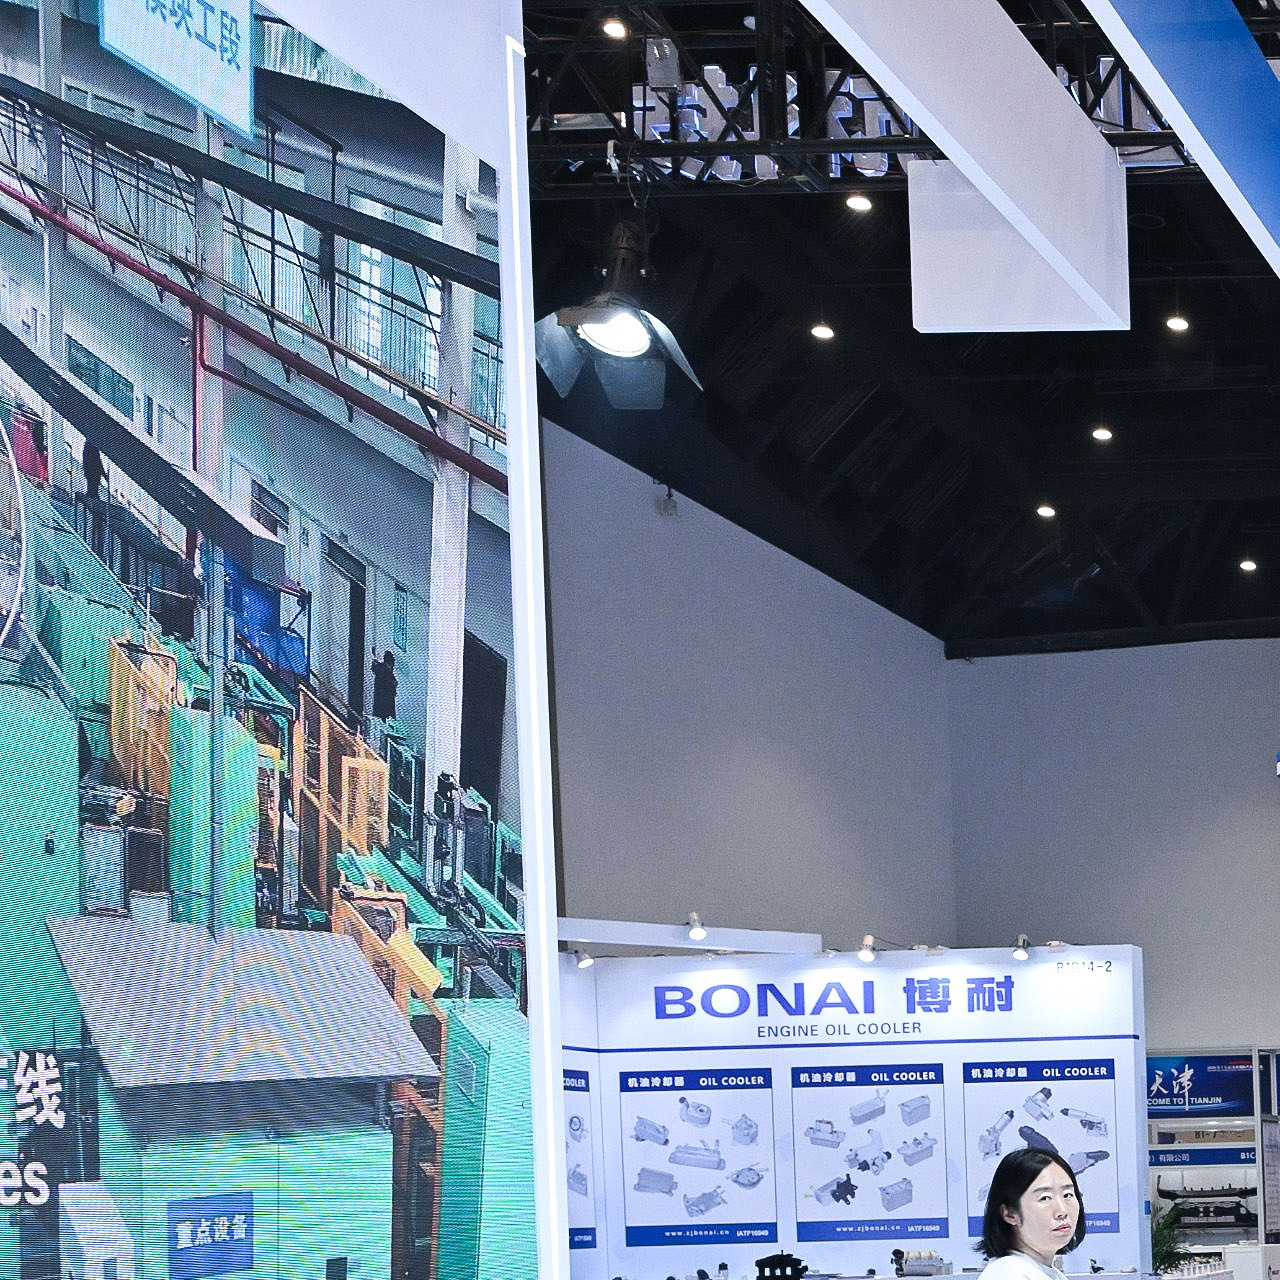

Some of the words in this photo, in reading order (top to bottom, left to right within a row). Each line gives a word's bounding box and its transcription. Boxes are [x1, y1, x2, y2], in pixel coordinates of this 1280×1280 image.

[654, 979, 874, 1020] BONAI
[902, 975, 1015, 1014] 博耐
[757, 1025, 819, 1038] ENGINE
[825, 1023, 851, 1036] OIL
[857, 1021, 922, 1035] COOLER
[800, 1071, 856, 1083] 机油冷却器
[871, 1072, 889, 1082] OIL
[893, 1071, 936, 1081] COOLER
[971, 1067, 1028, 1079] 机油冷却器
[1042, 1068, 1060, 1077] OIL
[1065, 1066, 1107, 1076] COOLER
[628, 1076, 685, 1088] 机油冷却器
[700, 1077, 718, 1086] OIL
[722, 1076, 764, 1086] COOLER
[1150, 1064, 1195, 1111] 天津
[13, 1050, 66, 1129] 线
[1147, 1098, 1171, 1106] COME
[1173, 1097, 1184, 1105] TO
[1191, 1096, 1222, 1104] TIANJIN
[1148, 1153, 1190, 1163] ）有限公司
[1240, 1152, 1257, 1162] B1C
[175, 1213, 248, 1250] 重点设备
